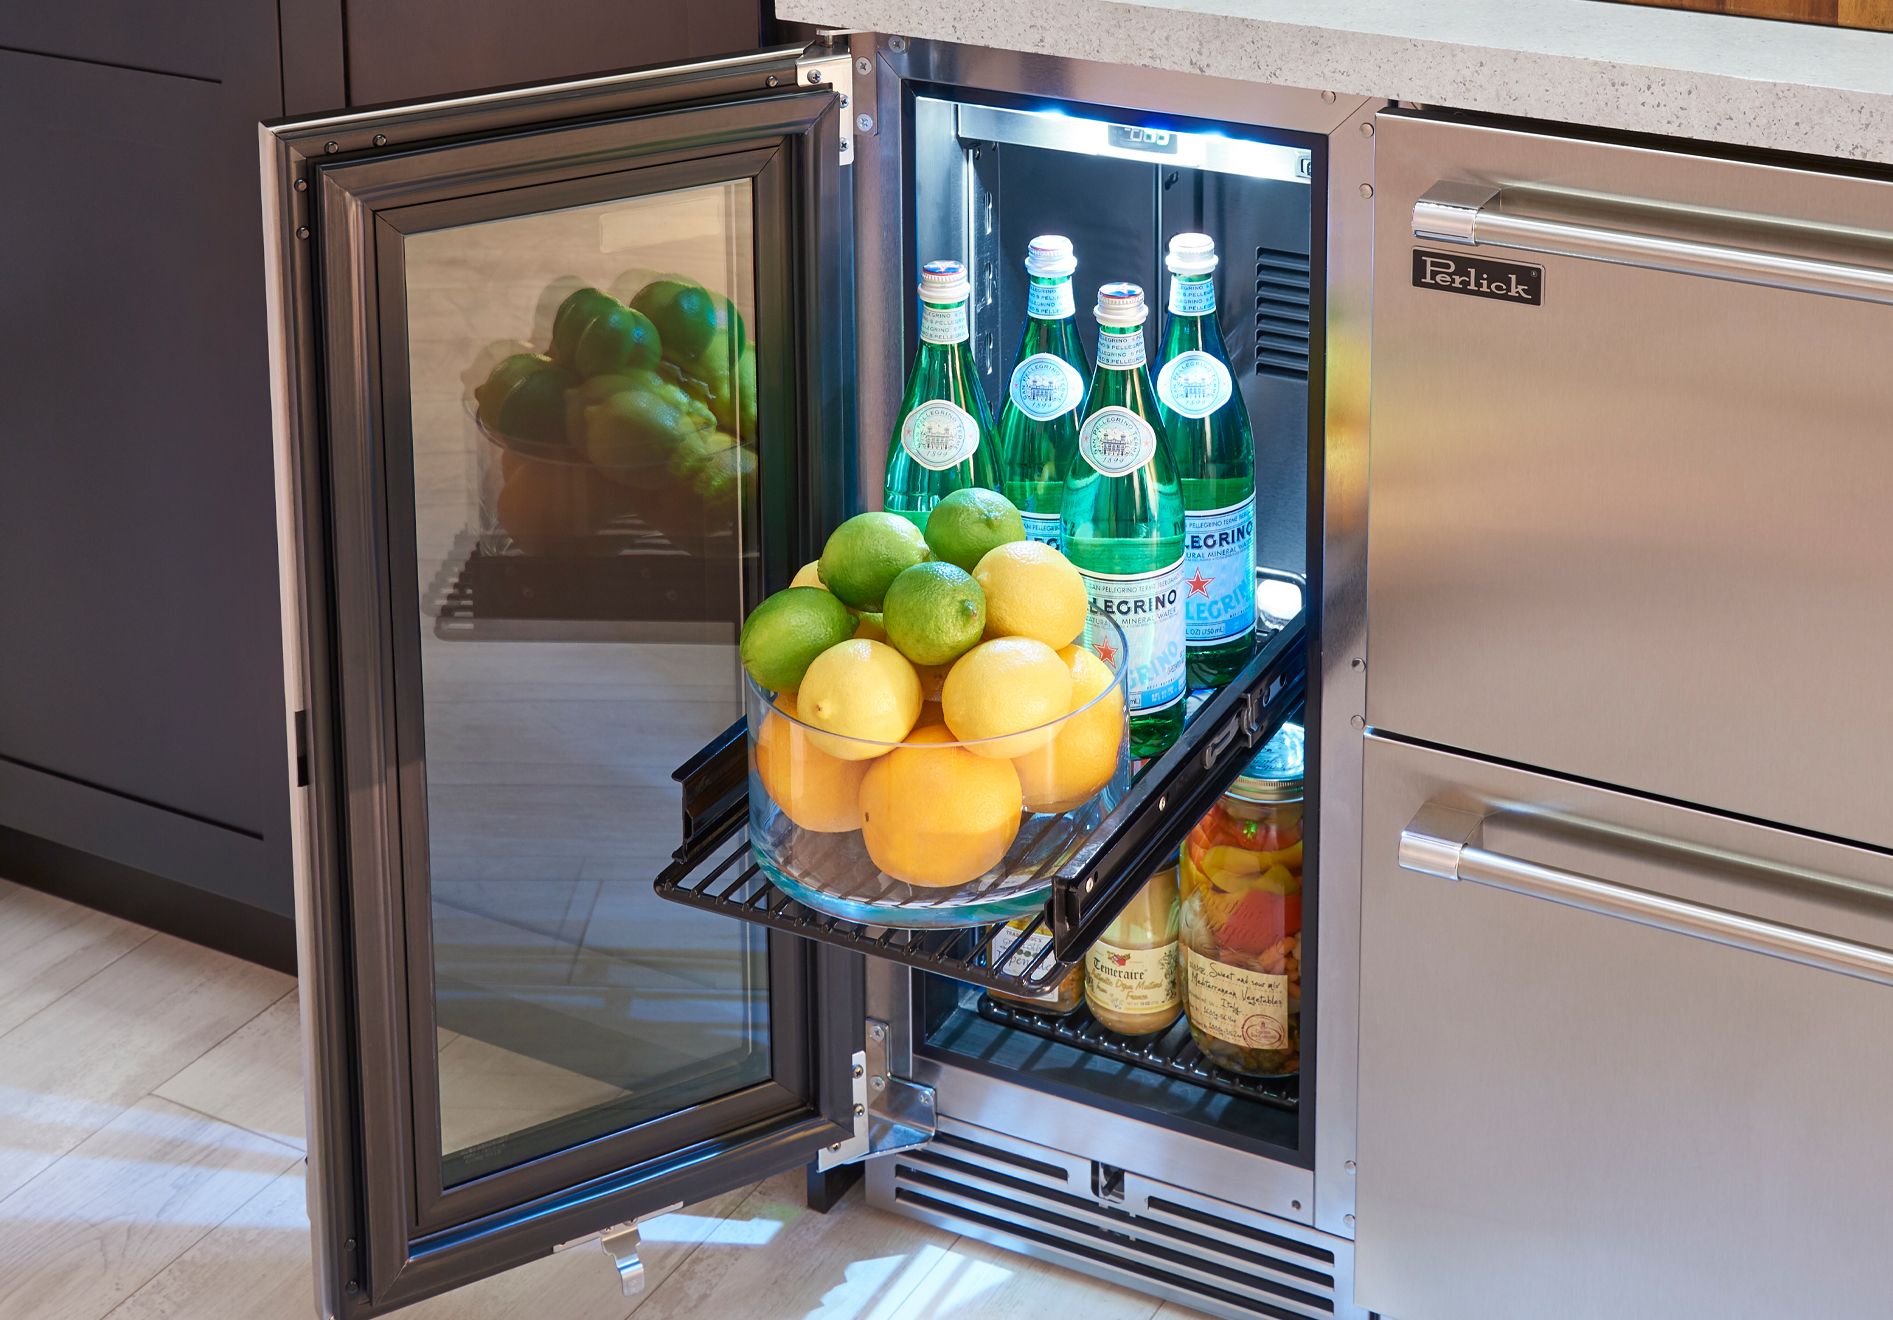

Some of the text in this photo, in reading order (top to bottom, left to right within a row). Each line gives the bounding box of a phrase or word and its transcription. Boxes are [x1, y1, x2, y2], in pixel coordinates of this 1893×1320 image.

[1421, 256, 1532, 299] Perlick
[1191, 972, 1238, 1000] Mediterranean
[1241, 987, 1283, 1006] Vegetables
[1209, 961, 1235, 981] Sweet
[1236, 975, 1249, 985] and
[1251, 978, 1267, 988] sour
